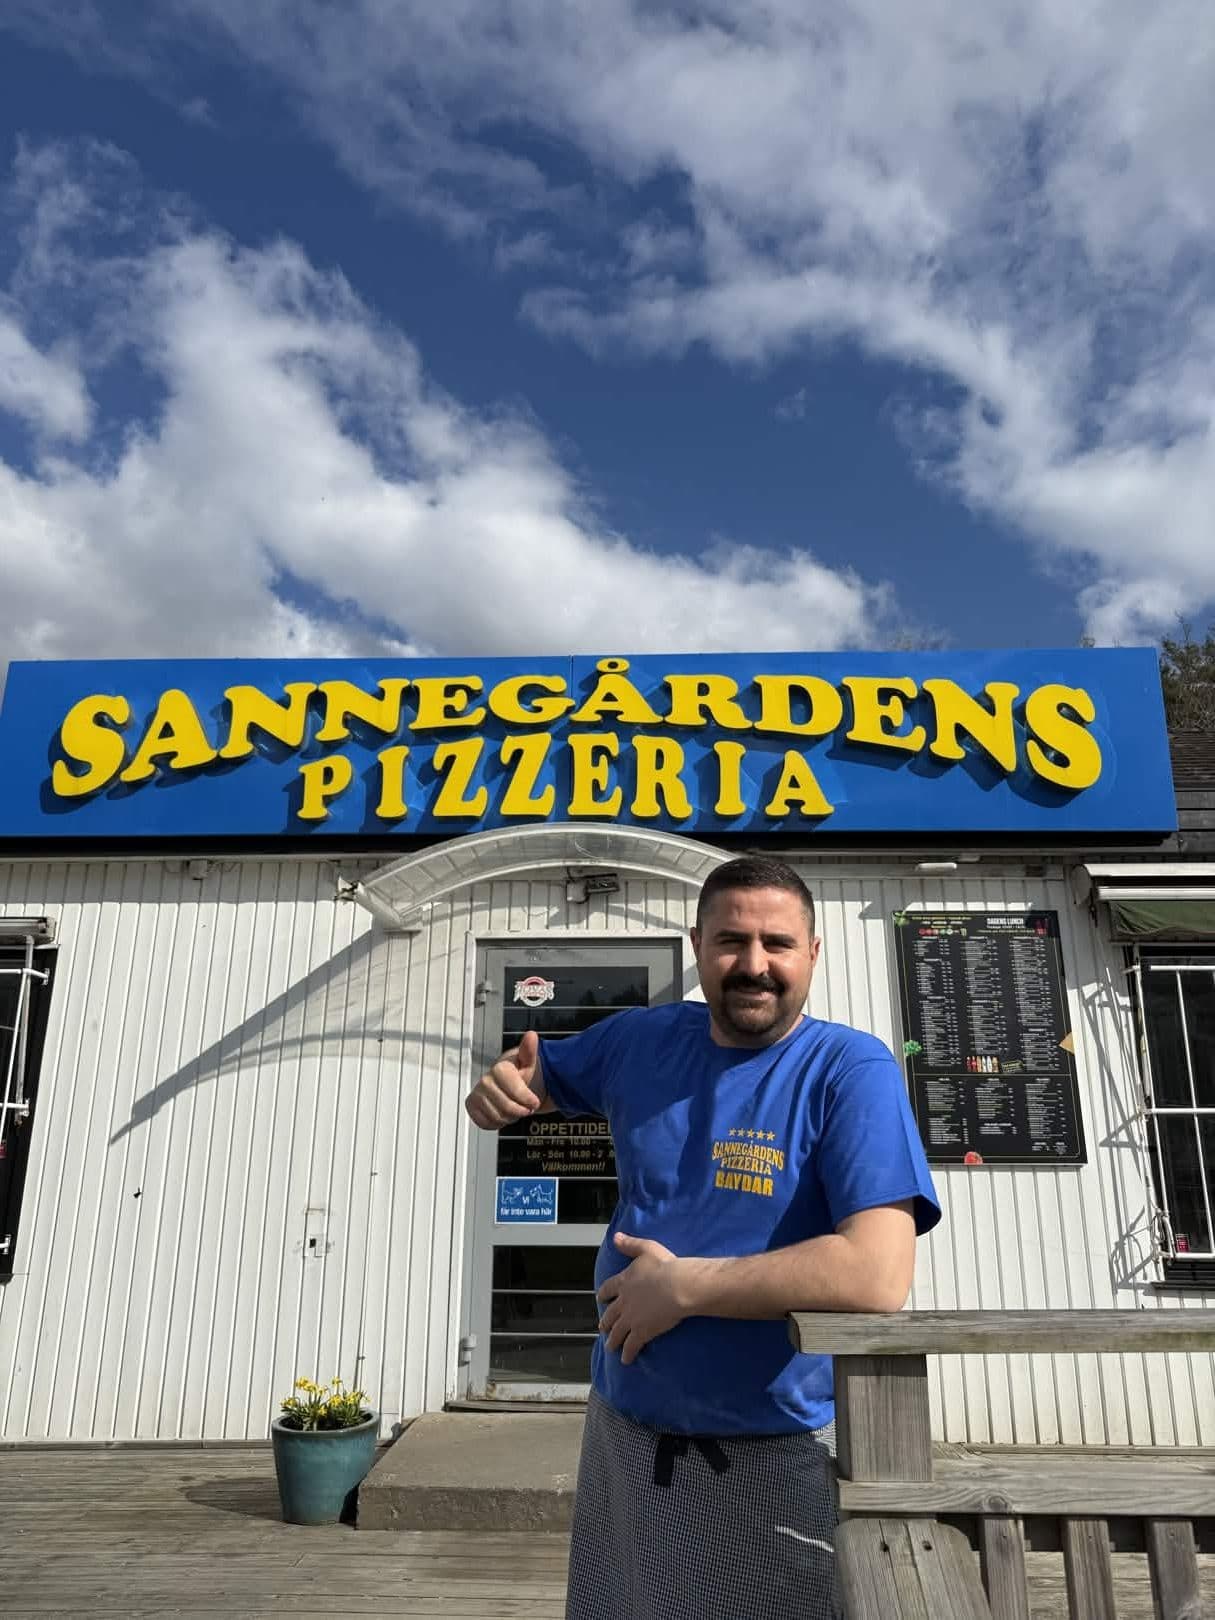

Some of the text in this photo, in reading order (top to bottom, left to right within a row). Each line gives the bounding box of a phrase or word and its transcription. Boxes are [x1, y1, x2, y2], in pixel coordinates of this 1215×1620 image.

[52, 657, 1102, 796] SANNEGÅRDENS
[297, 732, 834, 819] PIZZERIA
[529, 1122, 610, 1135] ÖPPETTIDE
[712, 1140, 785, 1171] SANNEGÅRDENS
[720, 1156, 772, 1175] PIZZERIA
[715, 1170, 774, 1196] BAYDAR
